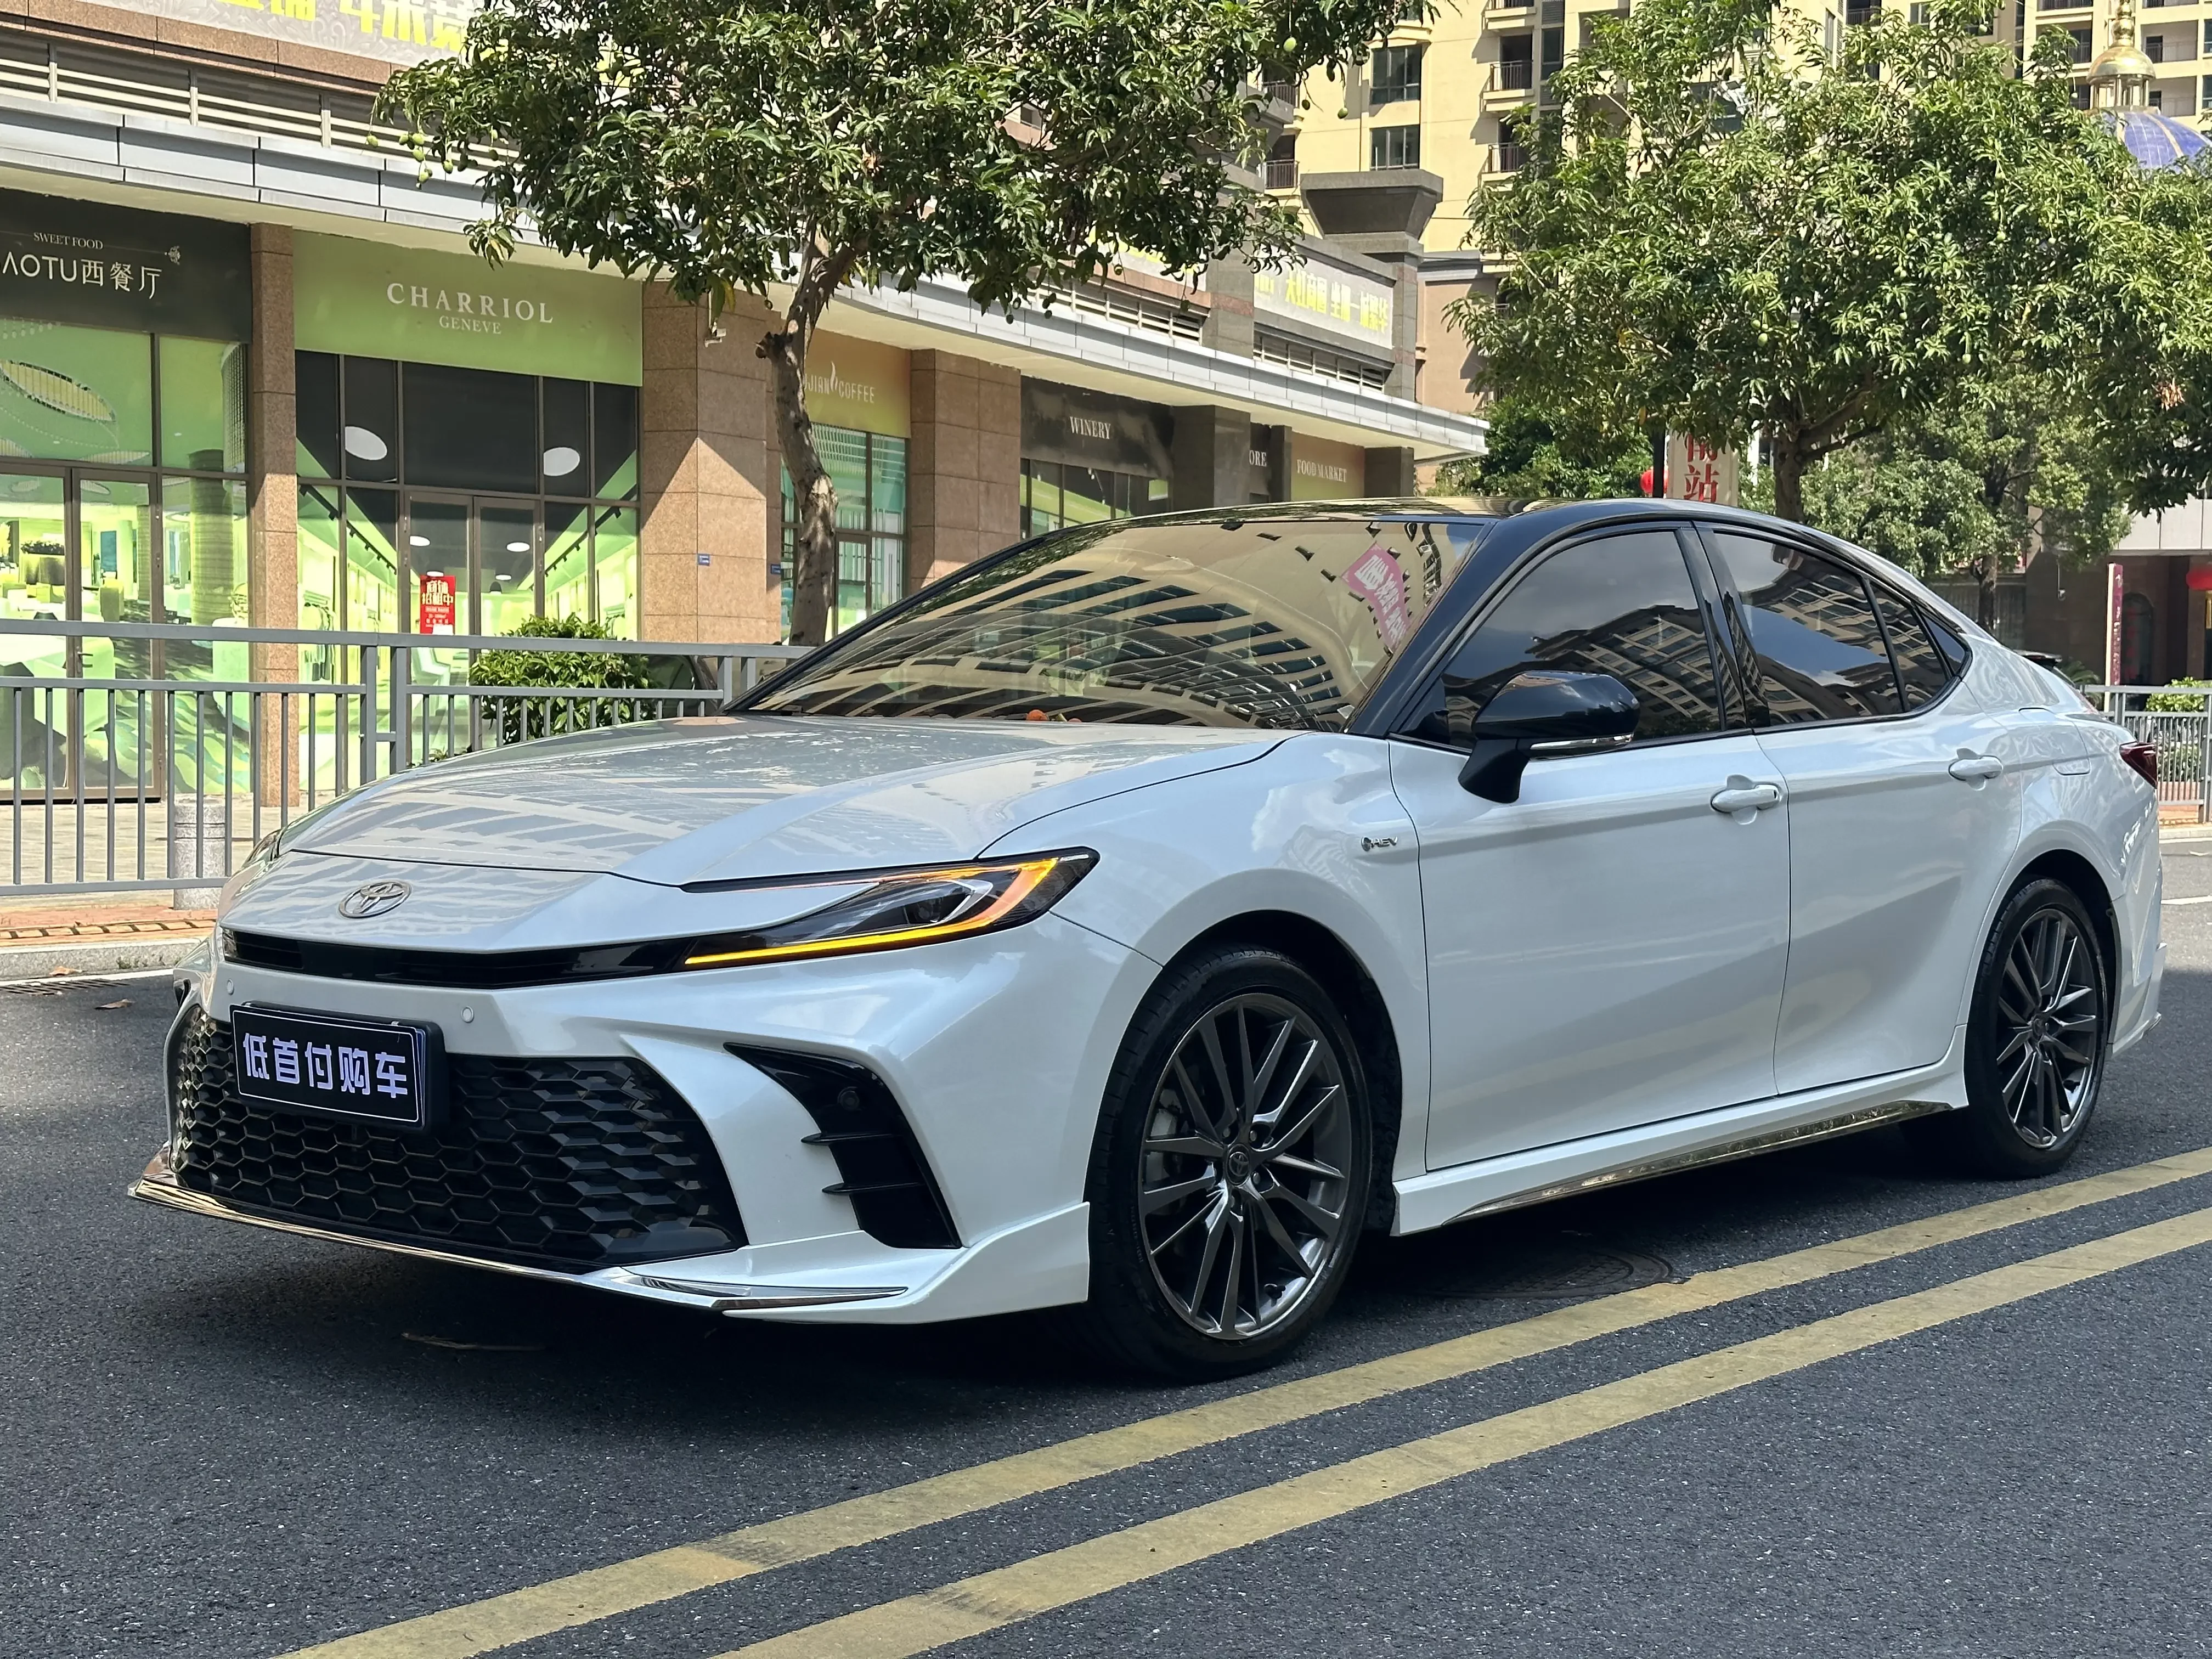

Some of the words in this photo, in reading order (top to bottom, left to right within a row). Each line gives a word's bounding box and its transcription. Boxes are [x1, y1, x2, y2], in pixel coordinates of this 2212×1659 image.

[33, 232, 70, 246] SWEET
[72, 236, 103, 250] FOOD
[387, 283, 554, 324] CHARRIOL
[439, 315, 501, 335] GENEVE
[839, 380, 875, 404] COFFEE
[1070, 416, 1111, 439] WINERY
[1297, 459, 1316, 476] FOOD
[1318, 464, 1347, 483] MARKET
[242, 1032, 408, 1098] 低首付购车
